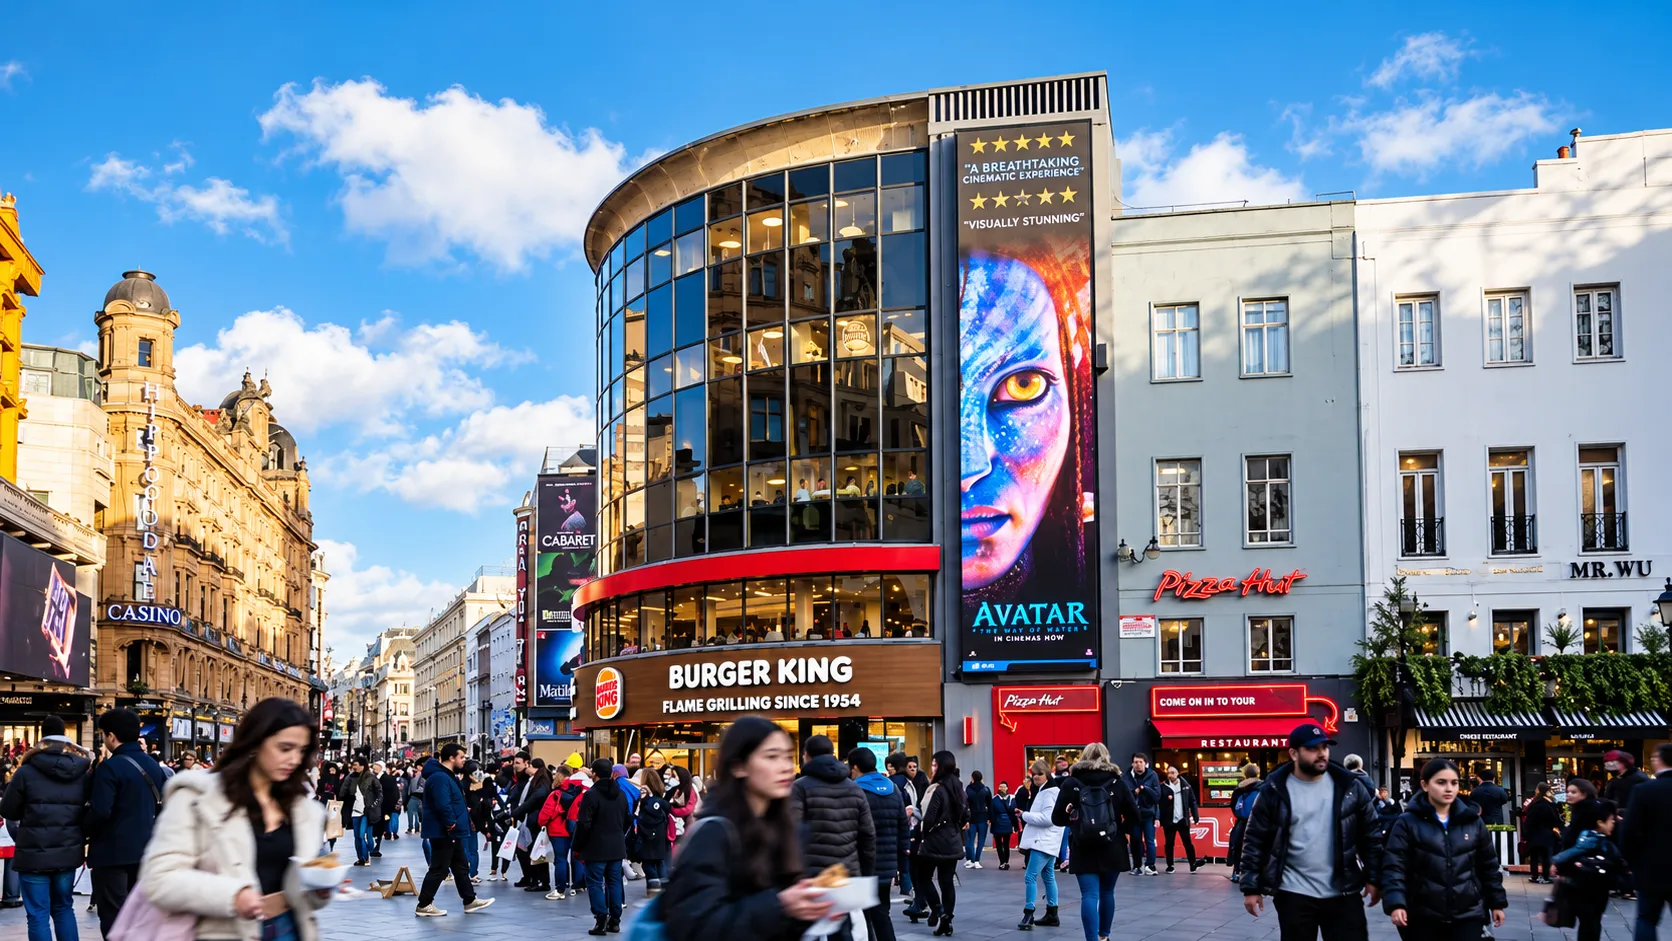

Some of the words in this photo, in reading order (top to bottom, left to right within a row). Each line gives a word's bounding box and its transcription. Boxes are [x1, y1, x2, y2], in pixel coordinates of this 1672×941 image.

[982, 156, 1080, 172] BREATHTAKING
[962, 172, 1016, 184] CINEMATIC
[542, 534, 596, 547] CABARET
[1153, 569, 1238, 602] Pizza
[1241, 567, 1308, 596] Hut
[107, 604, 181, 625] CASINO
[972, 601, 1089, 627] AVATAR
[669, 659, 771, 690] BURGER
[778, 656, 853, 684] KING
[662, 699, 704, 714] FLAME
[706, 696, 772, 712] GRILLING
[774, 695, 820, 710] SINCE
[822, 693, 862, 709] 1954
[1003, 694, 1037, 708] Pizza
[1037, 694, 1064, 706] Hut
[1159, 698, 1187, 706] COME
[1216, 697, 1229, 705] TO
[1230, 696, 1256, 705] YOUR
[1201, 738, 1288, 747] RESTAURANT
